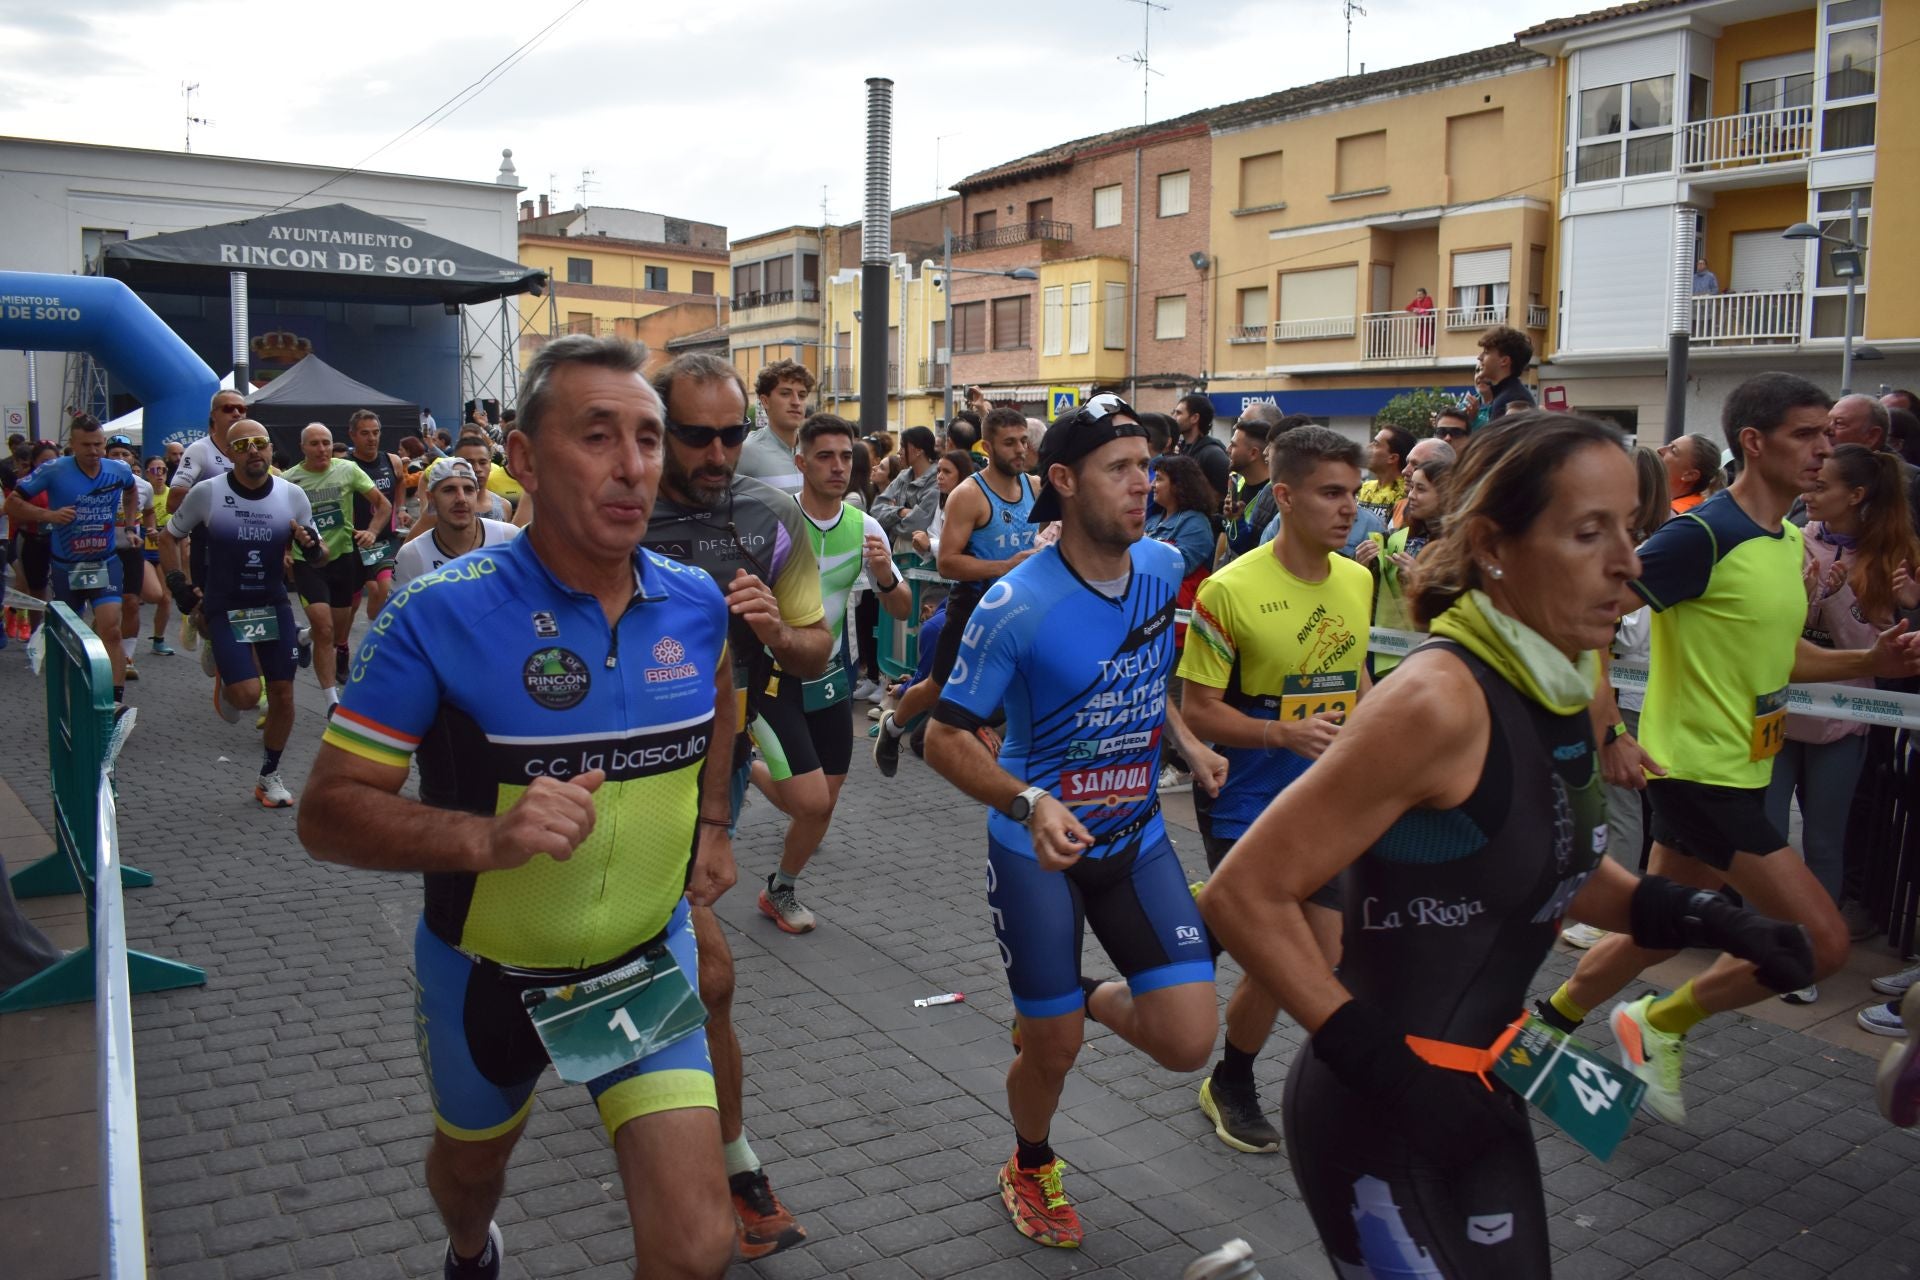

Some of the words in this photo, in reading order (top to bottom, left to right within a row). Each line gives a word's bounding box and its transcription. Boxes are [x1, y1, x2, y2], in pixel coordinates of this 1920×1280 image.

[268, 226, 413, 249] AYUNTAMIENTO
[220, 244, 328, 269] RINCON
[339, 252, 375, 272] DE
[385, 257, 456, 276] SOTO
[8, 306, 31, 319] DE
[36, 308, 80, 320] SOTO
[46, 298, 60, 306] DE
[162, 431, 184, 446] CLUB
[318, 515, 335, 528] 34
[238, 527, 272, 542] ALFARO
[80, 574, 98, 584] 13
[373, 612, 394, 636] la
[392, 557, 497, 609] bascula
[244, 623, 266, 638] 24
[1296, 604, 1328, 645] RINCON
[530, 652, 562, 672] PERAS
[566, 657, 580, 670] DE
[645, 662, 699, 684] BRUNA
[1097, 644, 1160, 682] TXELU
[824, 682, 834, 699] 3
[1084, 674, 1166, 709] ABLITAS
[1074, 696, 1165, 728] TRIATLON
[1852, 704, 1865, 712] DE
[1866, 706, 1904, 716] NAVARRA
[1874, 700, 1900, 708] RURAL
[580, 752, 604, 772] la
[612, 736, 706, 770] bascula
[1072, 766, 1148, 794] SANDUA
[1362, 896, 1402, 930] La
[1408, 896, 1486, 926] Rioja
[584, 983, 600, 994] DE
[602, 964, 648, 988] NAVARRA
[608, 1007, 641, 1042] 1
[1568, 1059, 1622, 1116] 42
